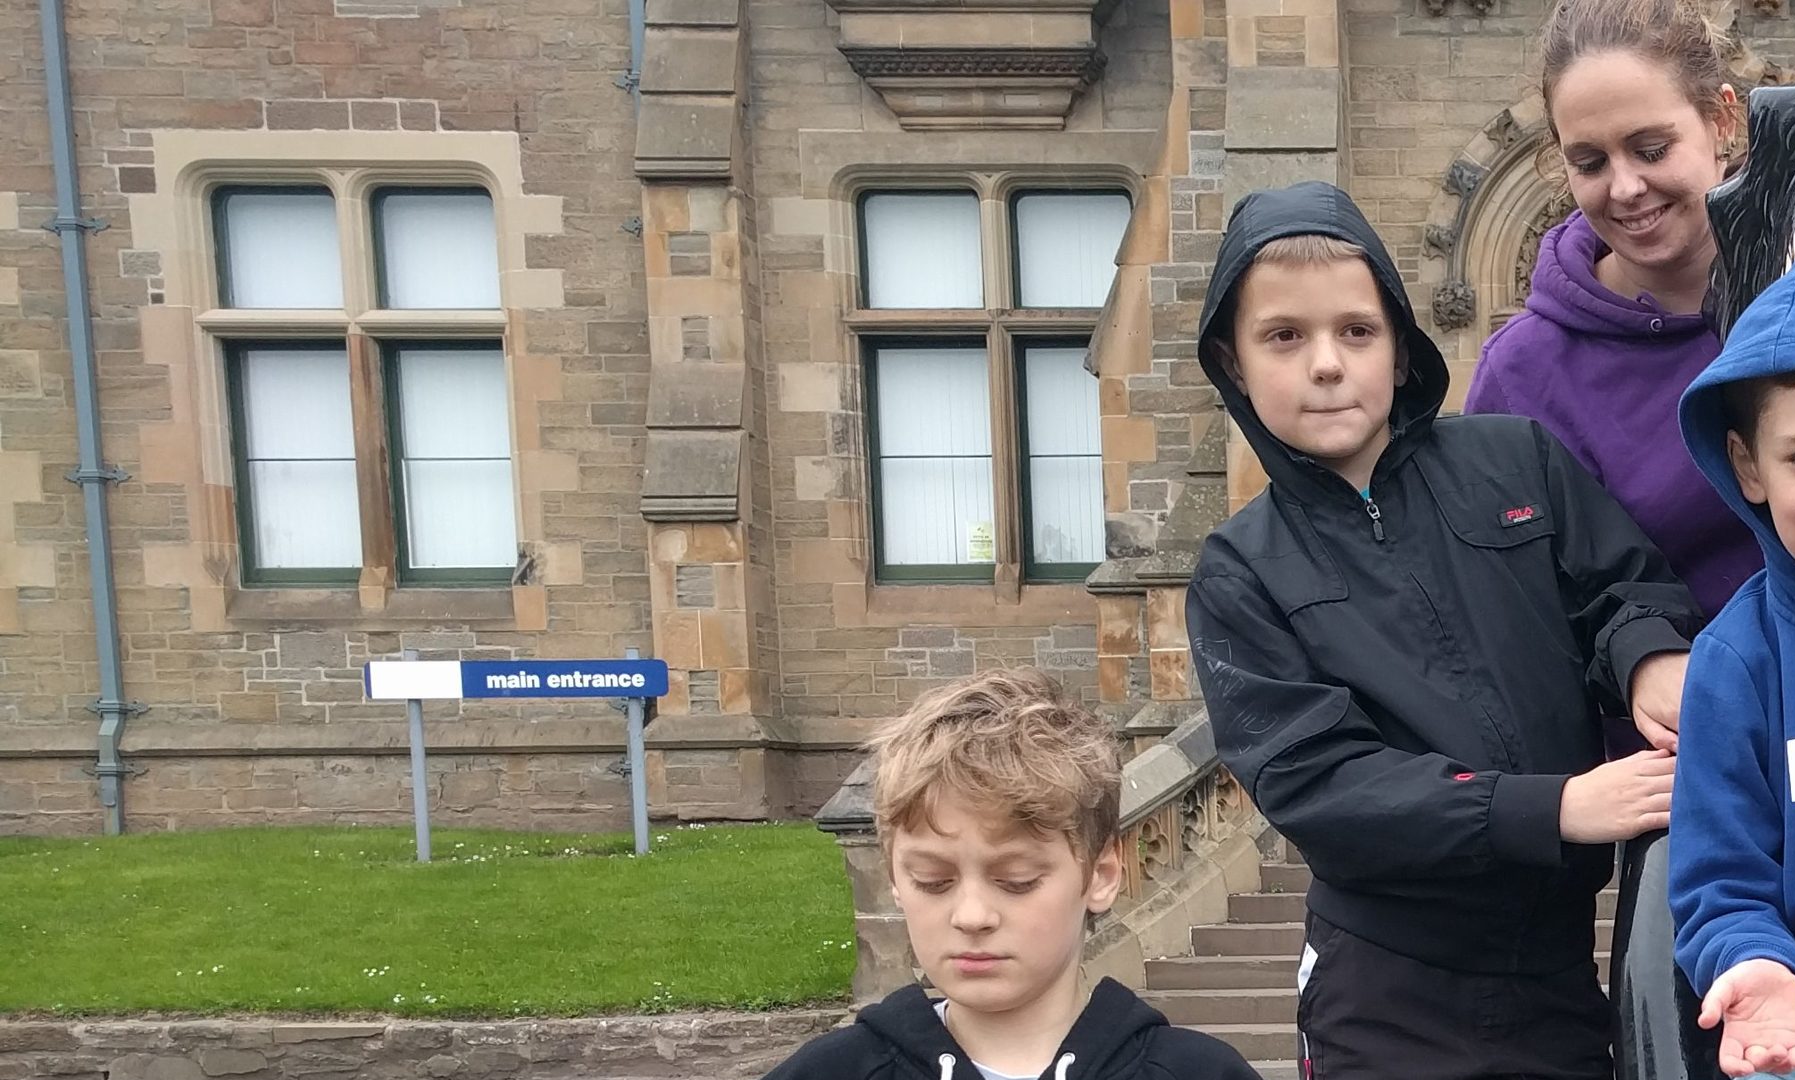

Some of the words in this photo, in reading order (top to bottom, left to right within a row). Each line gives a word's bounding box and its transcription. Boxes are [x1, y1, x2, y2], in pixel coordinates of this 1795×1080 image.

[1506, 506, 1534, 521] FILA
[486, 671, 541, 689] main
[547, 671, 646, 688] entrance
